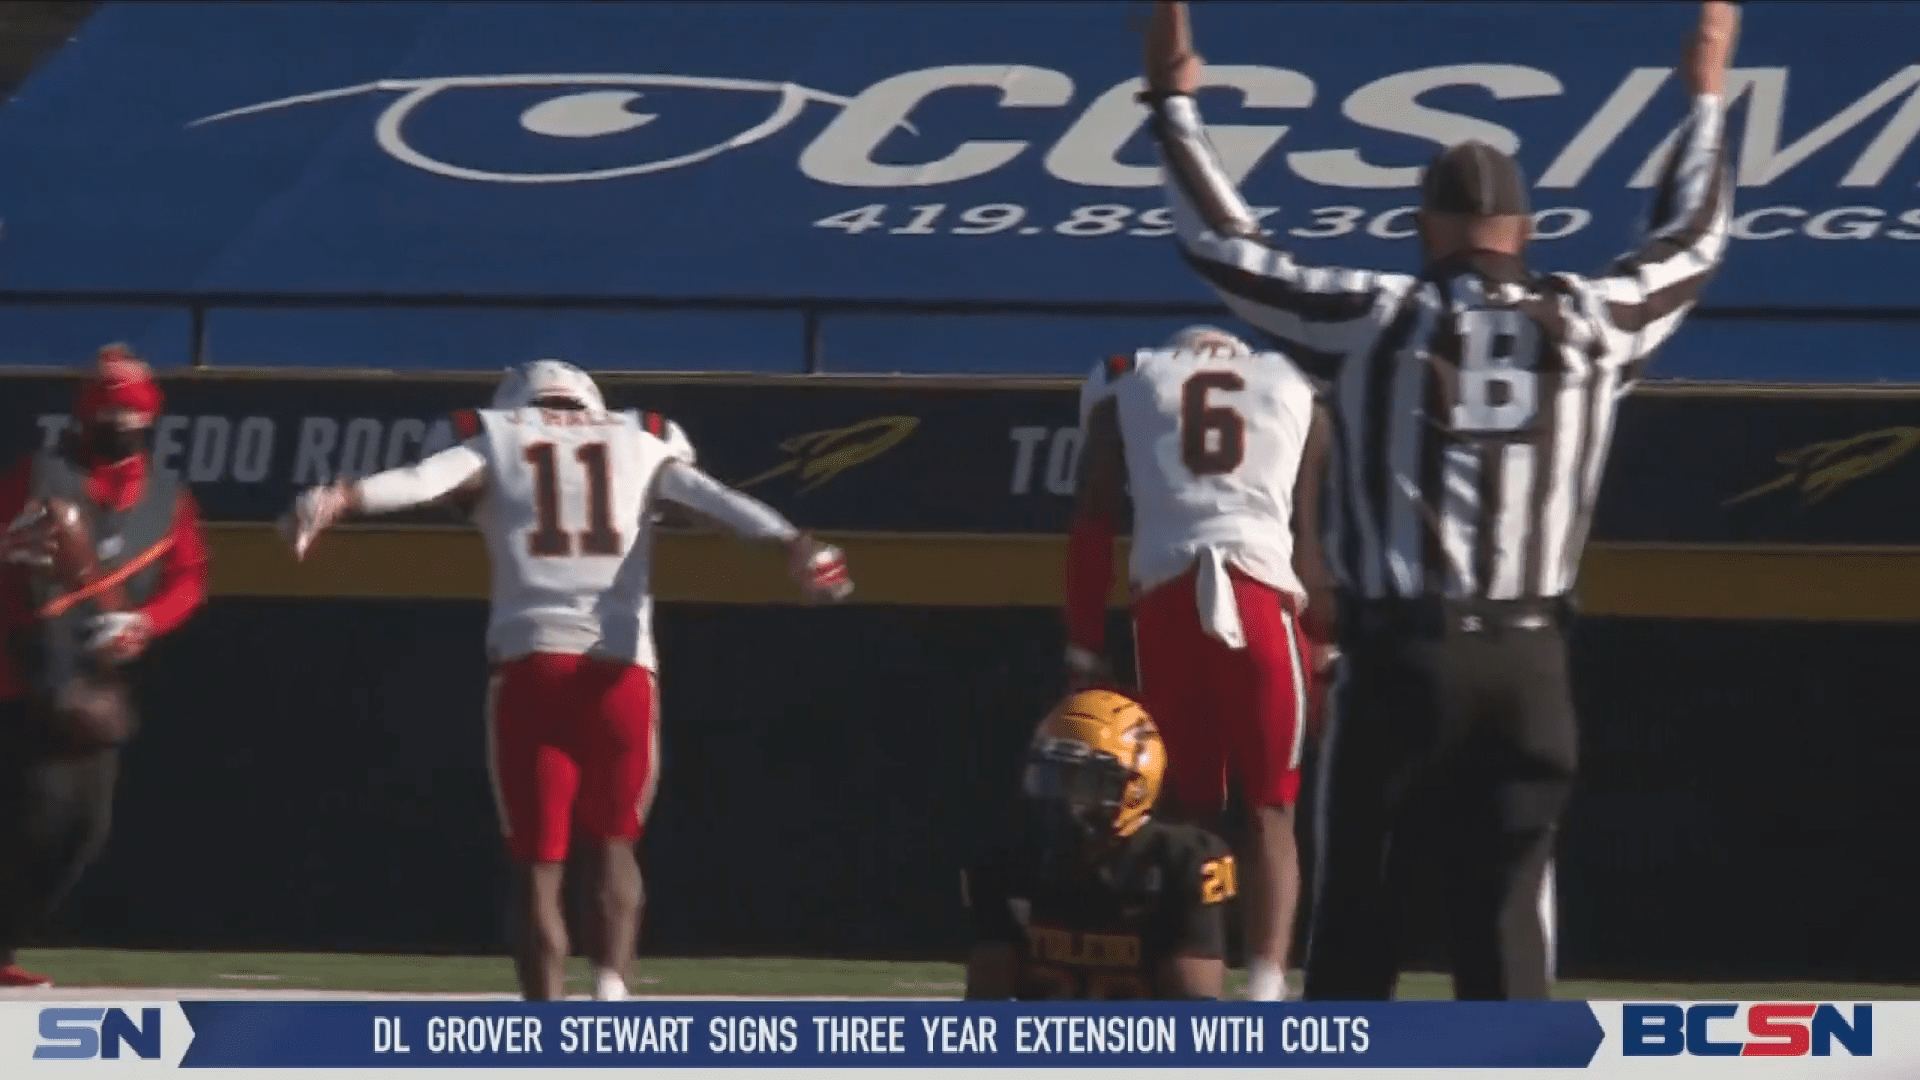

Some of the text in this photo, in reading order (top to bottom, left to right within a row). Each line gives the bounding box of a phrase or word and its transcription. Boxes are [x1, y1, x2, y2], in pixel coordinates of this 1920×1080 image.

[1181, 371, 1245, 474] 6
[1453, 310, 1538, 430] B
[37, 414, 275, 483] TEDO
[524, 442, 622, 556] 11
